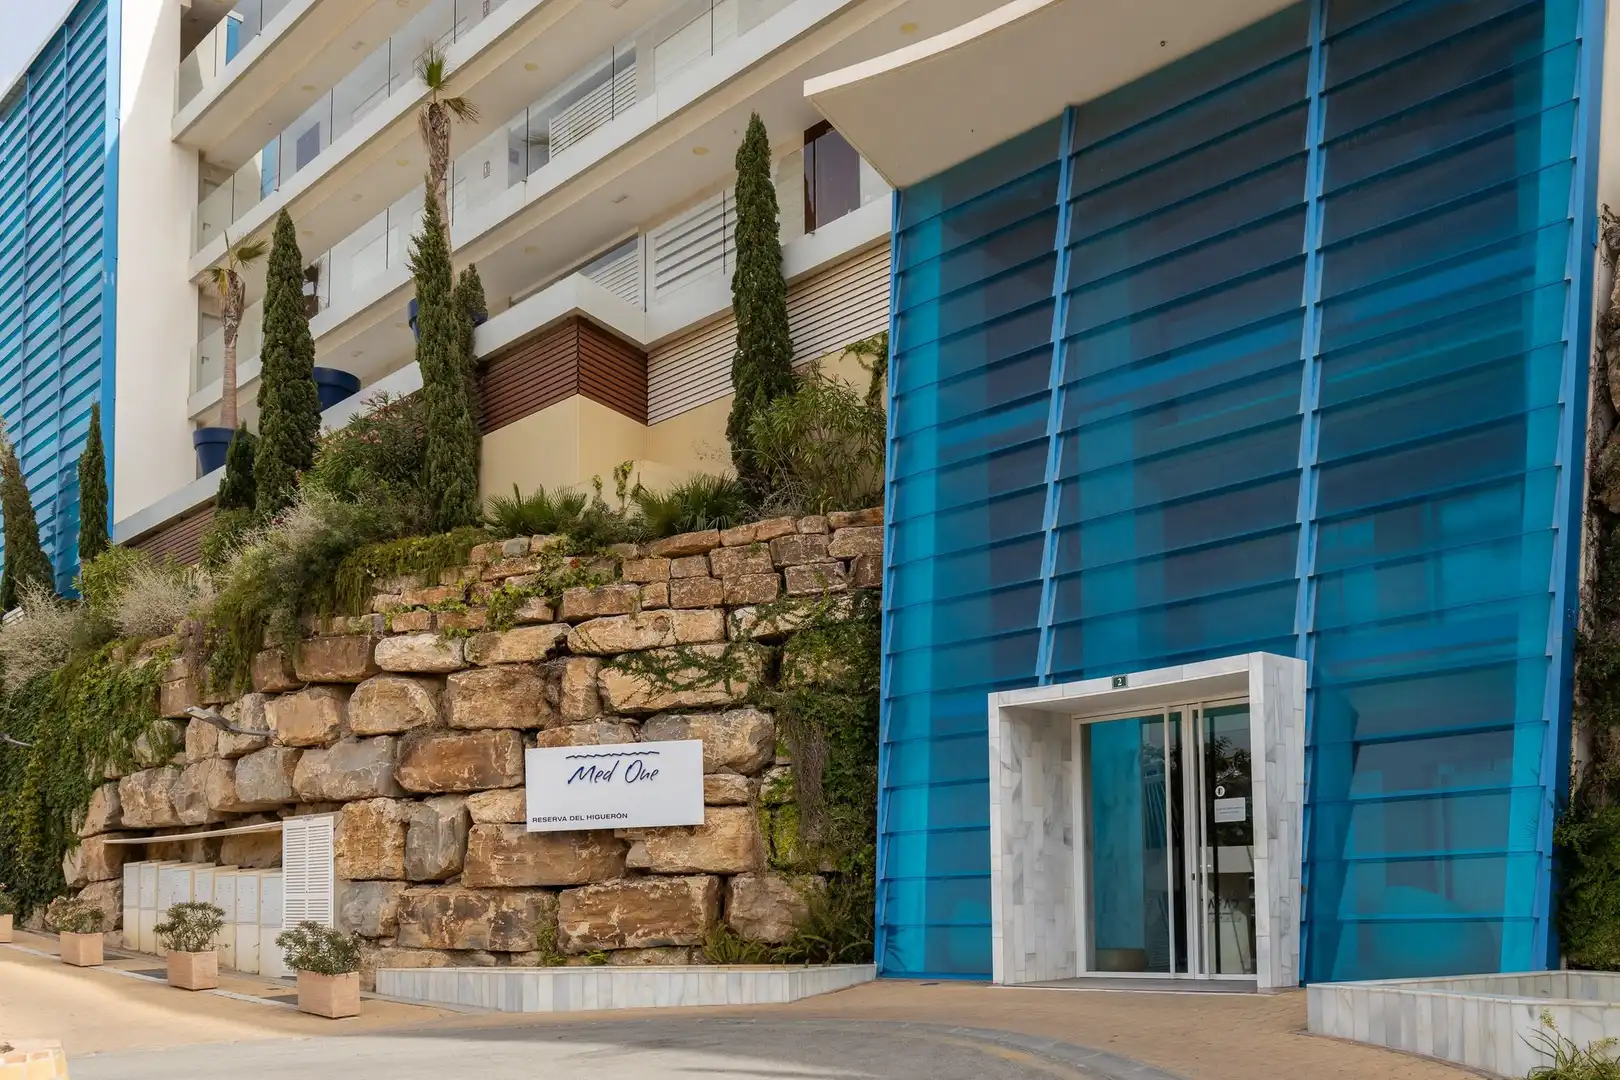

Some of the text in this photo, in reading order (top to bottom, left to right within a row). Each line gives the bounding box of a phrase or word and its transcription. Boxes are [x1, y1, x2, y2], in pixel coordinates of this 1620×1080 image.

[567, 759, 659, 784] Med One
[586, 812, 628, 821] HIGUERÓN
